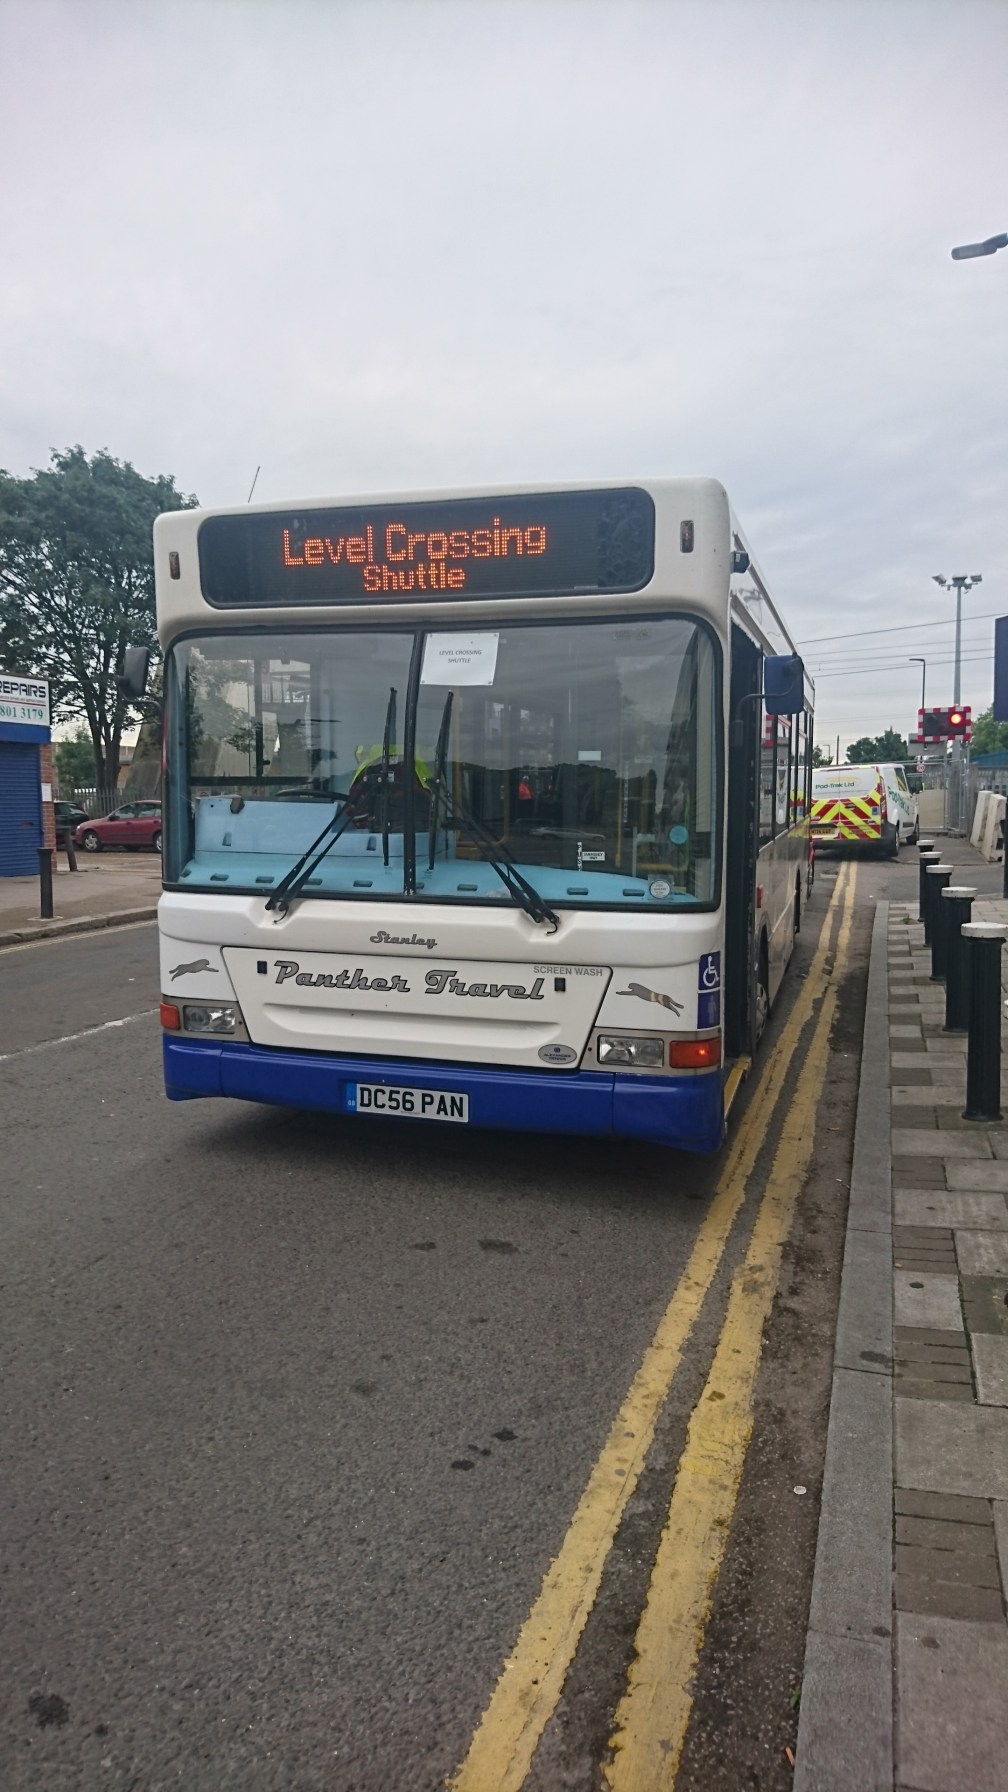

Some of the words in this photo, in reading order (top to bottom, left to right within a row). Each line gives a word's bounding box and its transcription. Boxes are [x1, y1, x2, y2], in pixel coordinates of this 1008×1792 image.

[284, 525, 373, 566] Level
[386, 518, 546, 561] Crossing
[363, 562, 465, 590] Shuttle
[20, 707, 44, 720] 3179
[370, 930, 438, 949] Stanley
[274, 960, 411, 993] Panther
[424, 969, 545, 1000] Travel
[533, 965, 572, 975] SCREEN
[575, 967, 603, 976] WASH
[359, 1086, 415, 1112] DC56
[421, 1092, 464, 1118] PAN
